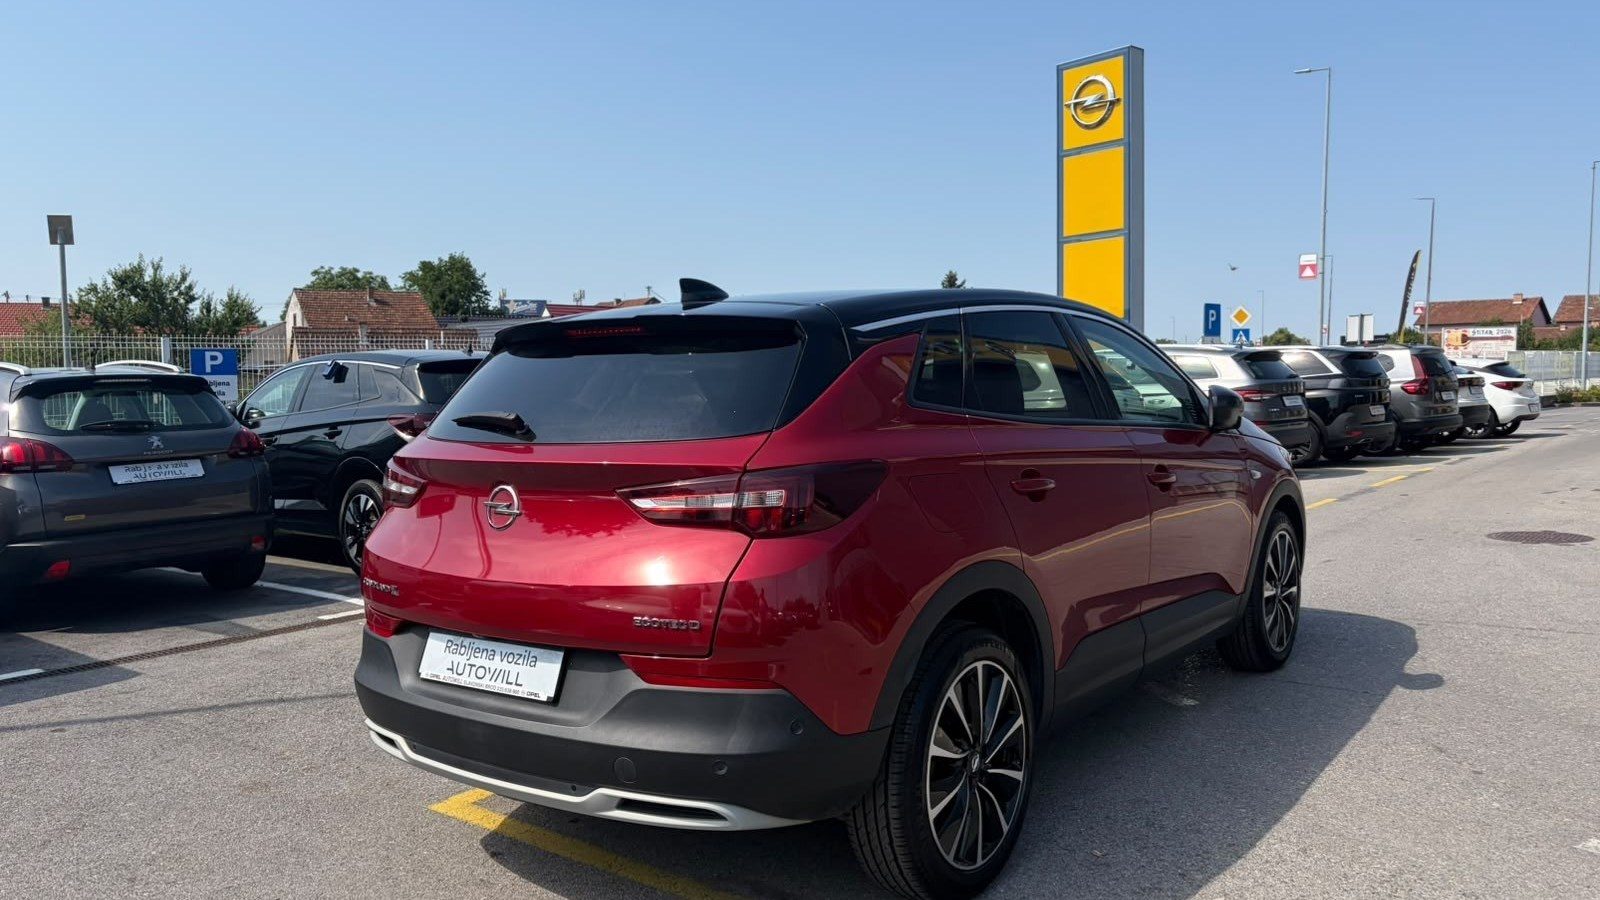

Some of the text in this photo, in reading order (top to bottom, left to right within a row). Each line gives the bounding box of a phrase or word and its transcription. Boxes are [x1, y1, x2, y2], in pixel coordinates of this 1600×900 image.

[1208, 309, 1216, 330] P
[204, 350, 223, 373] P
[443, 639, 538, 668] Rabljena vozila
